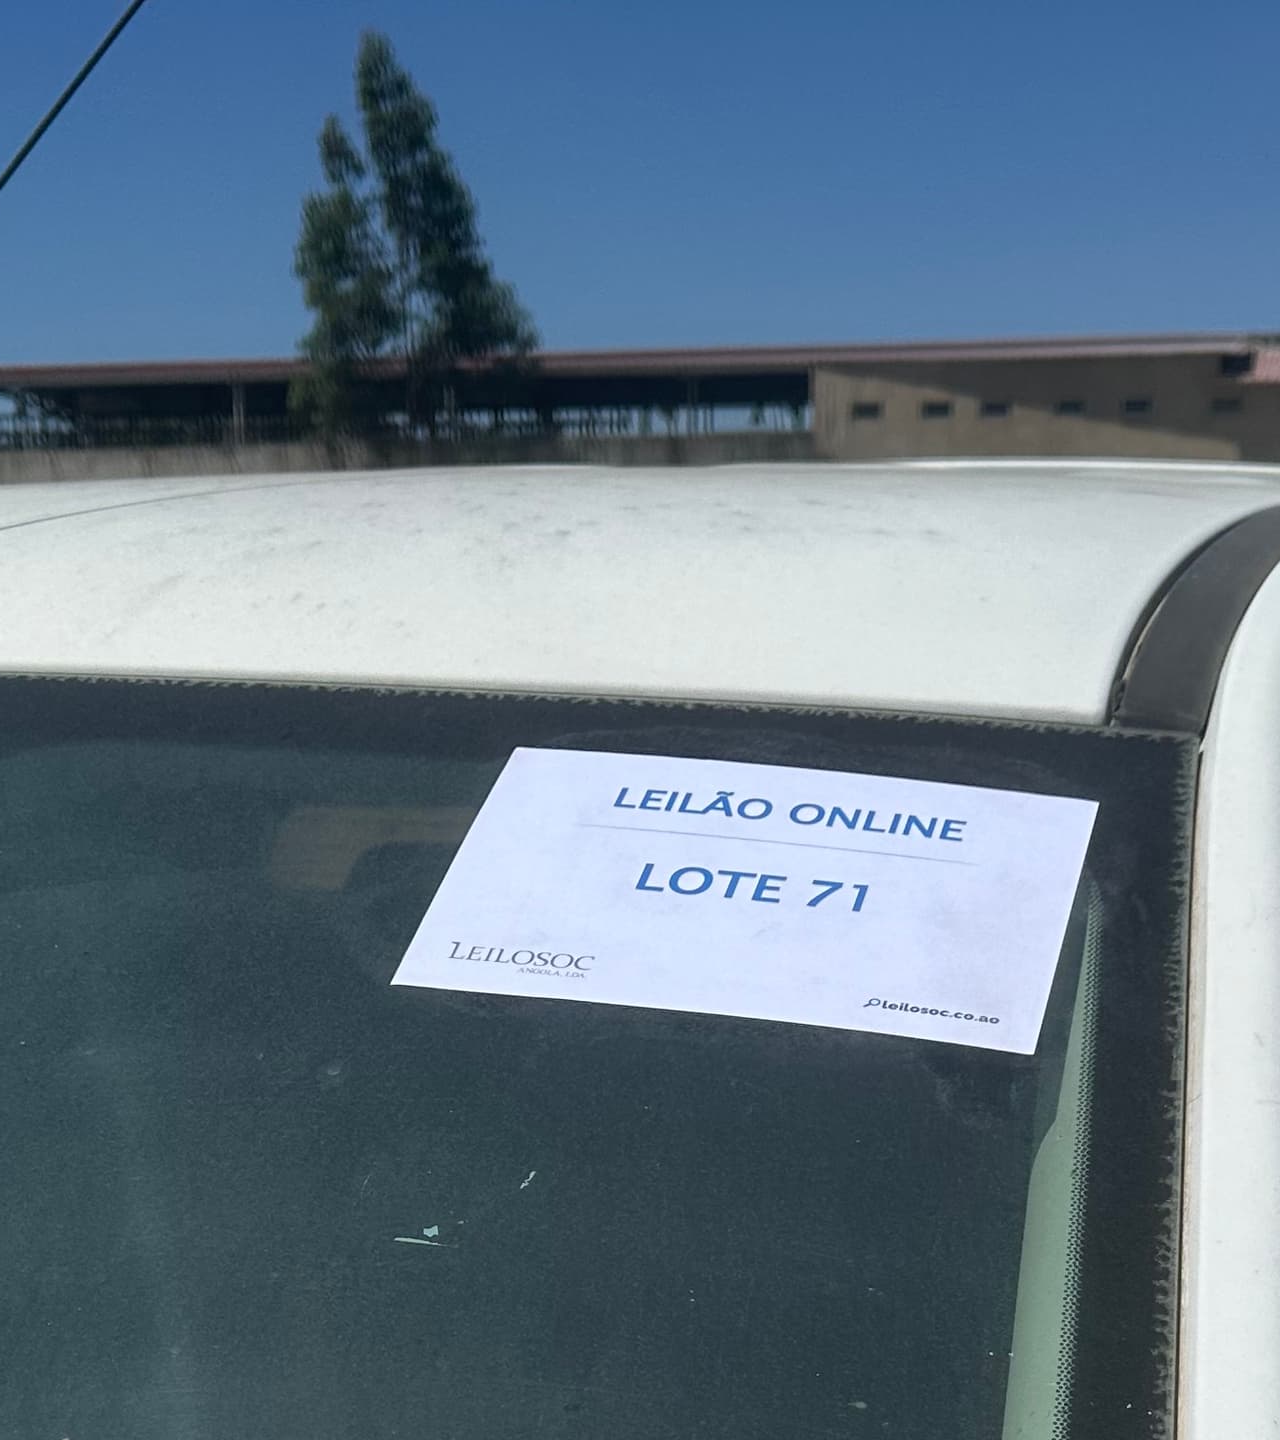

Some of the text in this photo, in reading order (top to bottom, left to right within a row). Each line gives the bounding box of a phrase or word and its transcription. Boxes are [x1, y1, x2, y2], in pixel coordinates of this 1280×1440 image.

[613, 787, 968, 842] LEILÃO ONLINE
[635, 863, 870, 913] LOTE 71
[448, 941, 595, 970] LEILOSOC
[881, 999, 1001, 1025] leilosoc.co.ao
